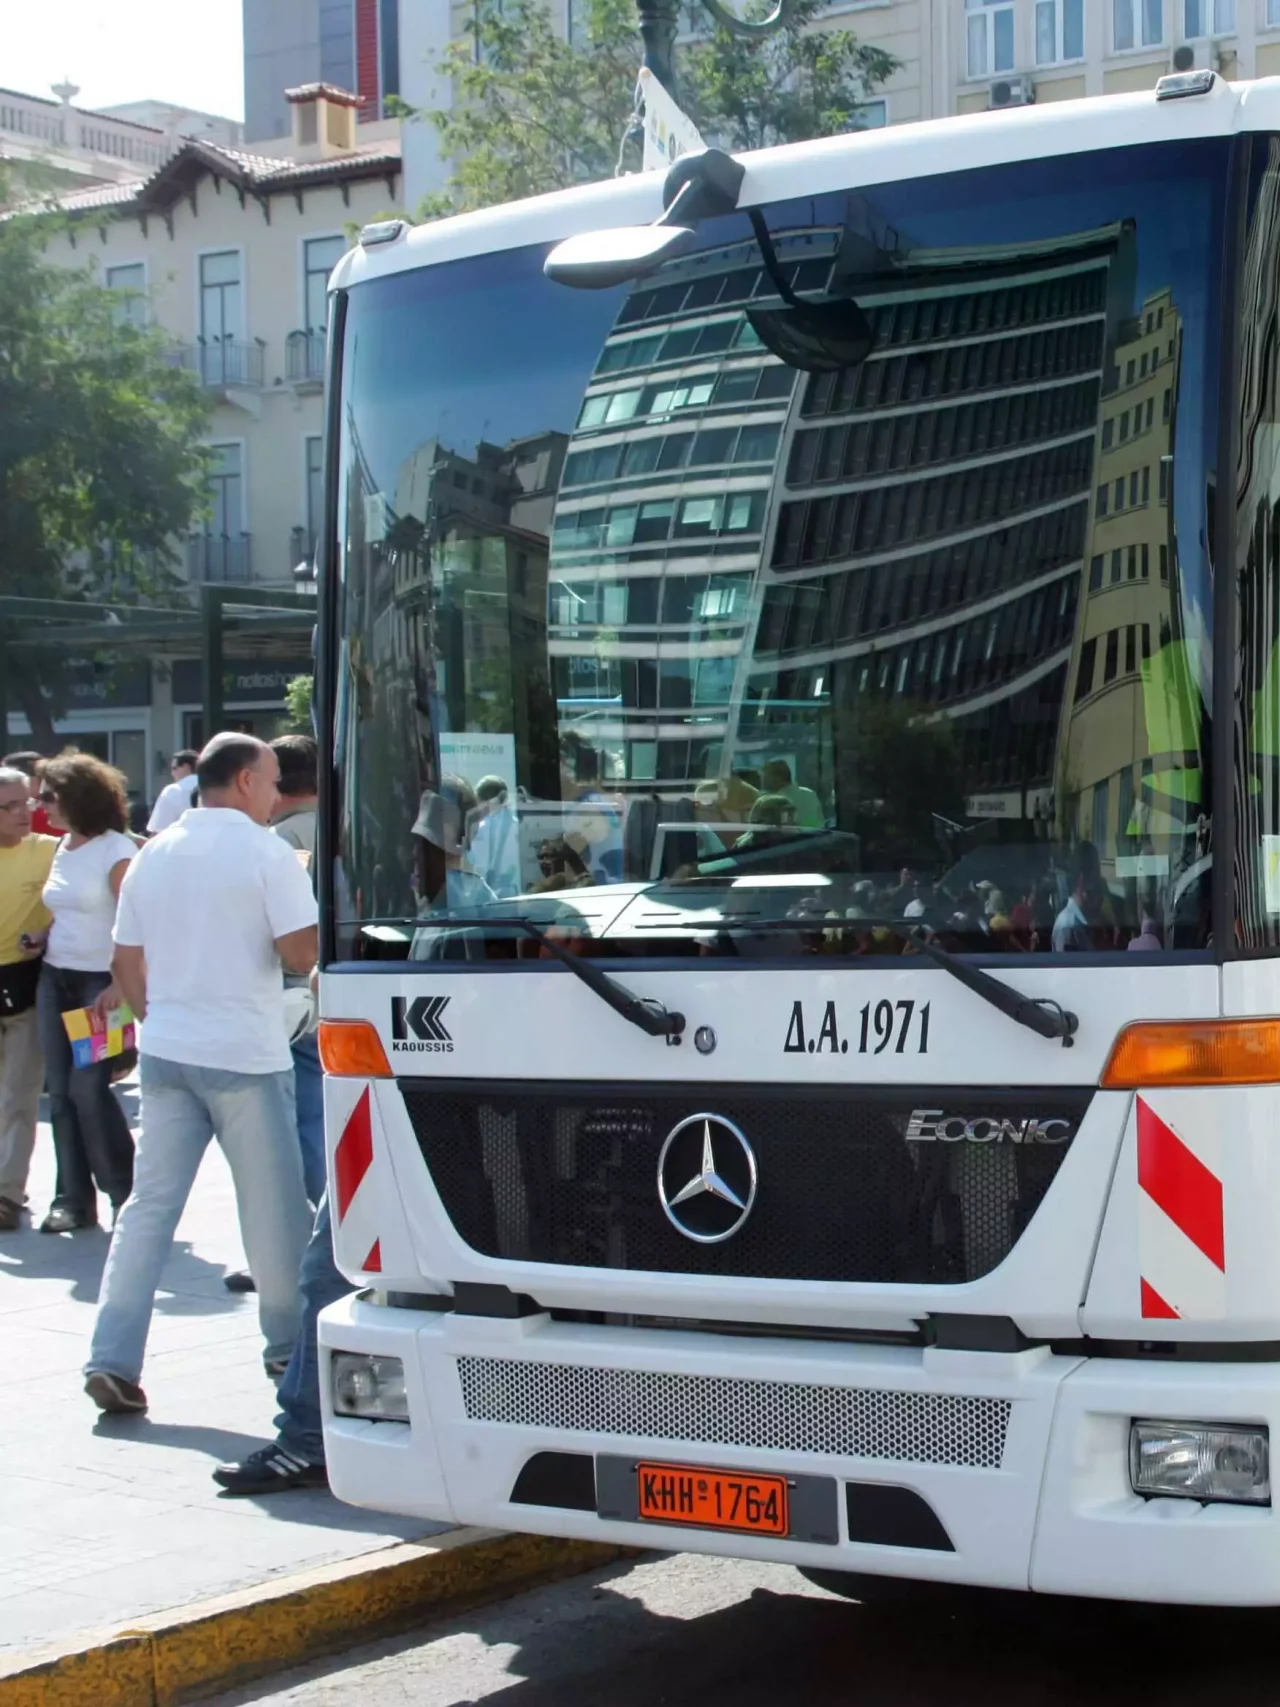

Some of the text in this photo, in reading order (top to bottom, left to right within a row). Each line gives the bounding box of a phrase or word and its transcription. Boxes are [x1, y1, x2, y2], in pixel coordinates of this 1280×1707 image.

[783, 999, 930, 1055] Δ.Α. 1971
[392, 1041, 455, 1053] KAOUSSIS
